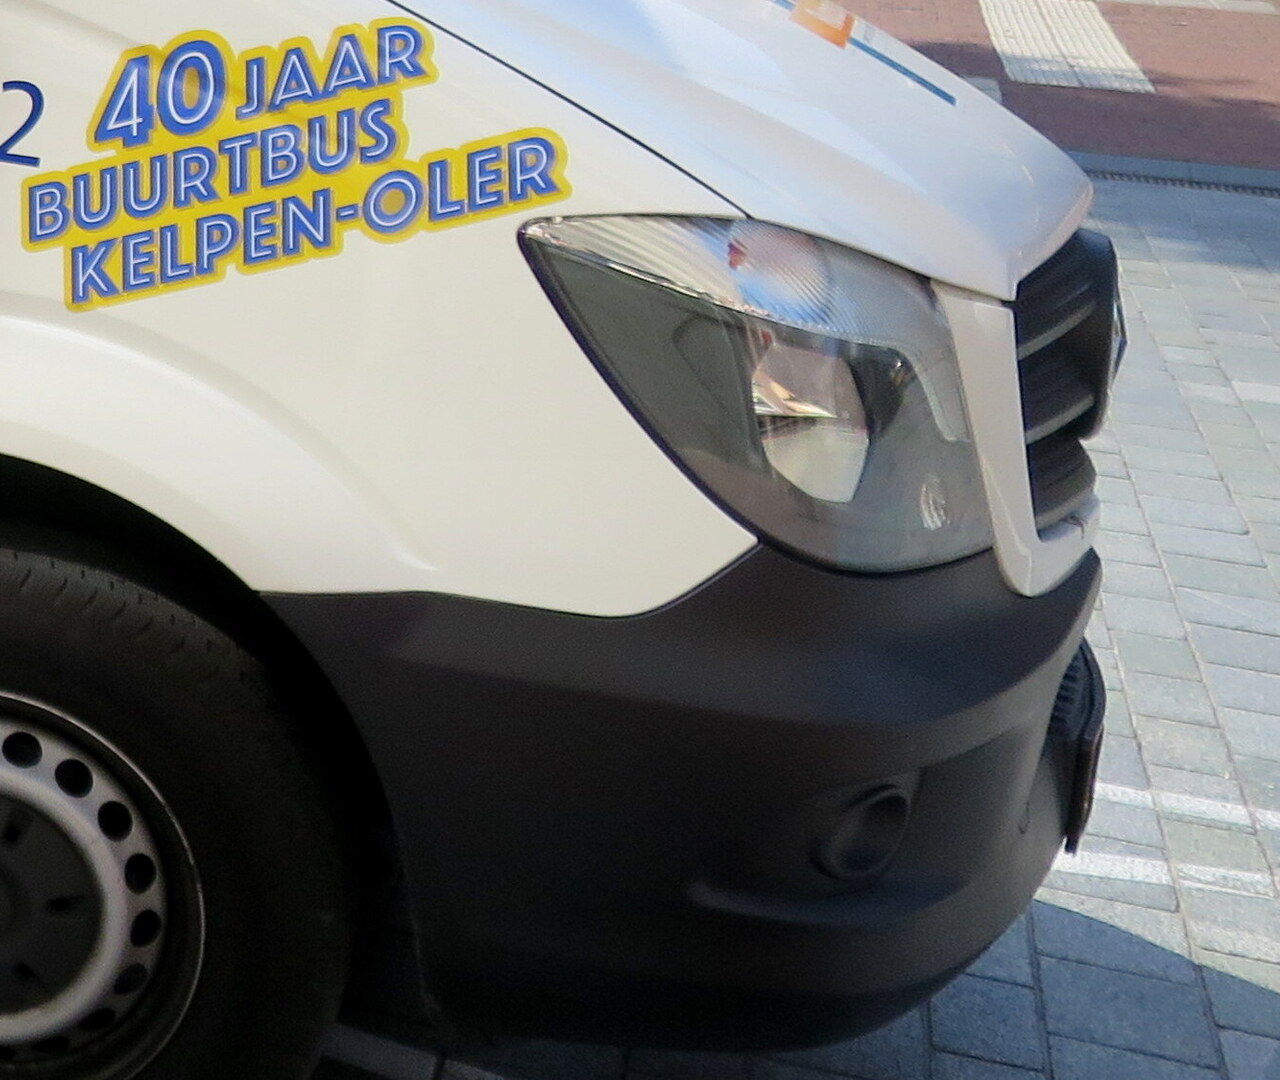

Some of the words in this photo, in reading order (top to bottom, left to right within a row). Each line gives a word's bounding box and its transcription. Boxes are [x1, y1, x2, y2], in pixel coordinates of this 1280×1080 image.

[92, 38, 229, 150] 40
[235, 23, 429, 122] JAAR
[28, 98, 400, 245] BUURTBUS
[70, 135, 562, 306] KELPEN-OLER
